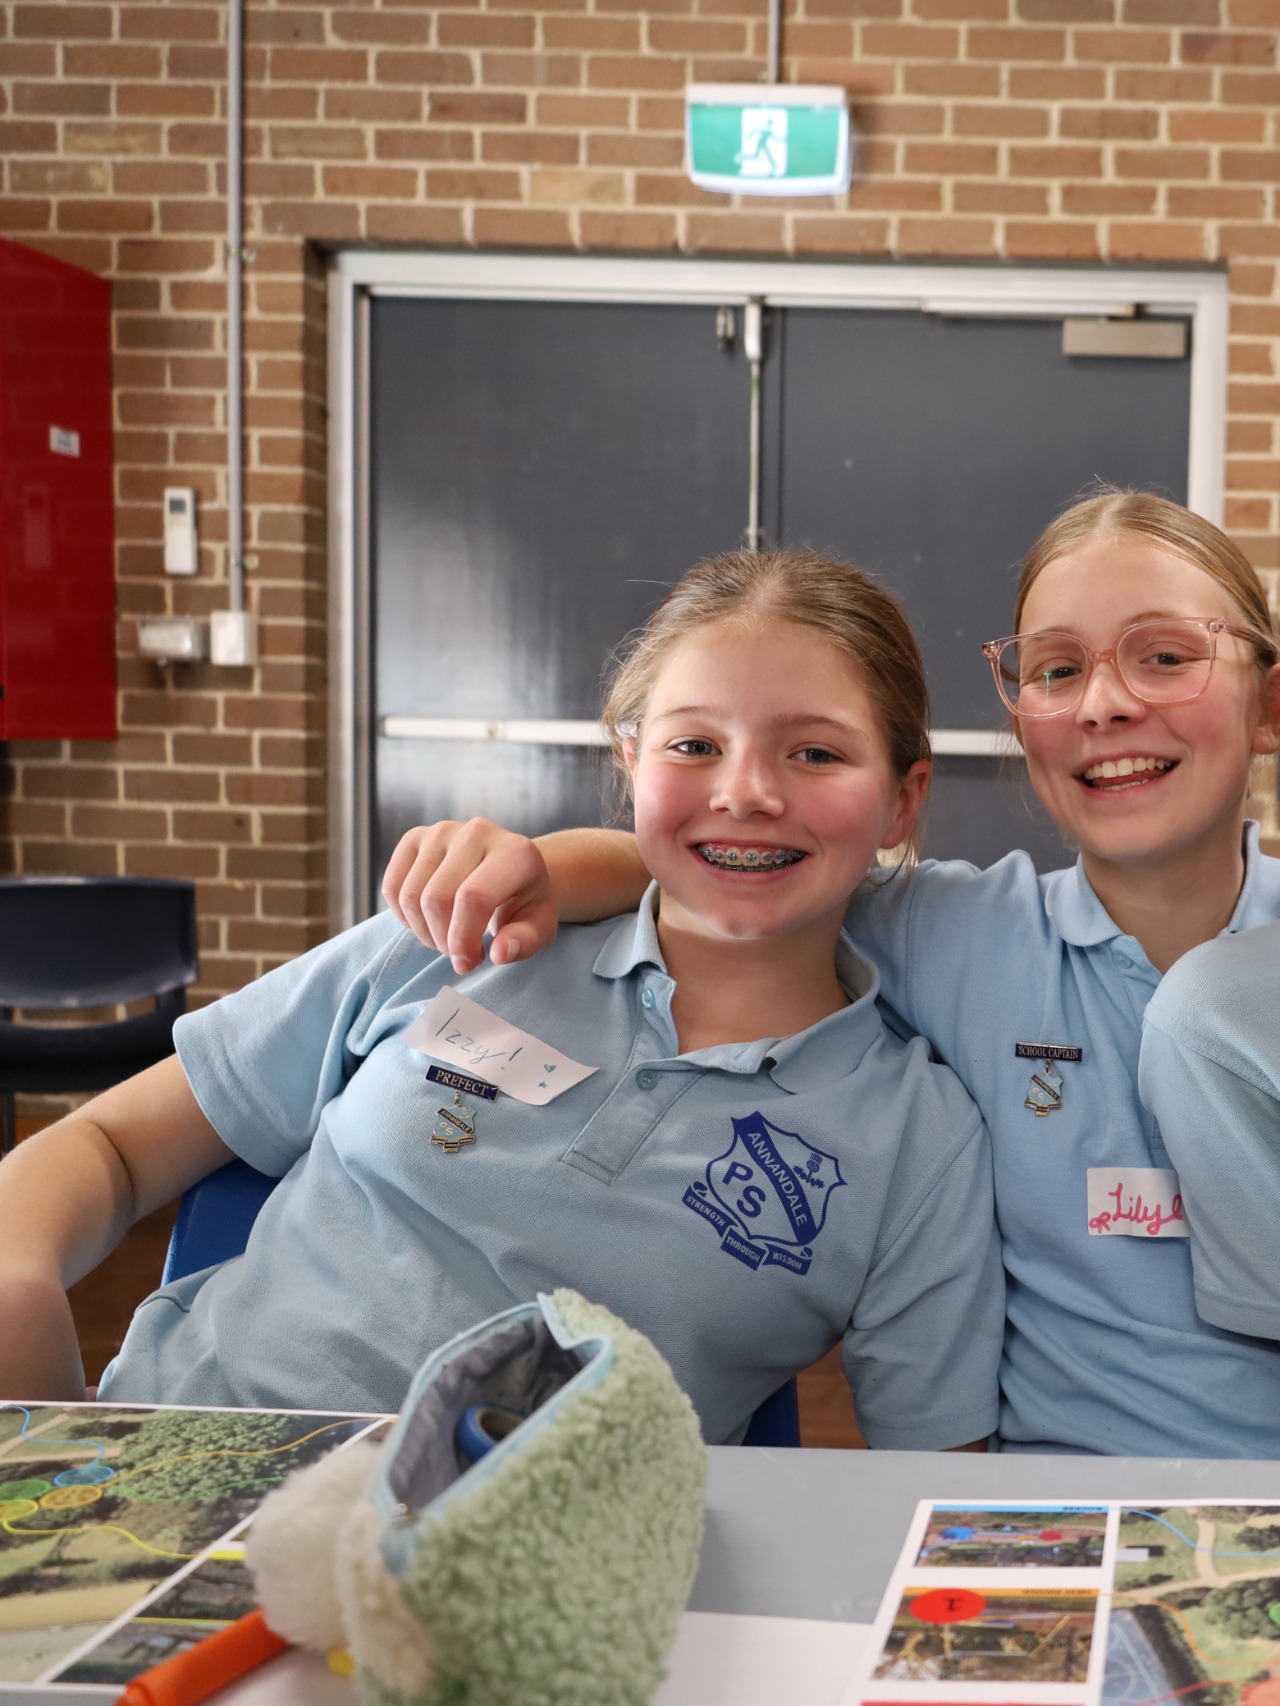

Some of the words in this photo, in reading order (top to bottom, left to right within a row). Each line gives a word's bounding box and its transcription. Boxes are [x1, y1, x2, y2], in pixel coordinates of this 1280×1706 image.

[435, 1008, 523, 1070] Izzy!
[1018, 1045, 1047, 1057] SCHOOL
[1048, 1048, 1079, 1060] CAPTAIN
[435, 1069, 489, 1096] PREFECT
[722, 1161, 767, 1218] PS
[747, 1132, 808, 1227] ANNANDALE
[686, 1196, 726, 1227] STRENGTH
[726, 1236, 761, 1263] THROUGH
[772, 1251, 803, 1270] WISDOM
